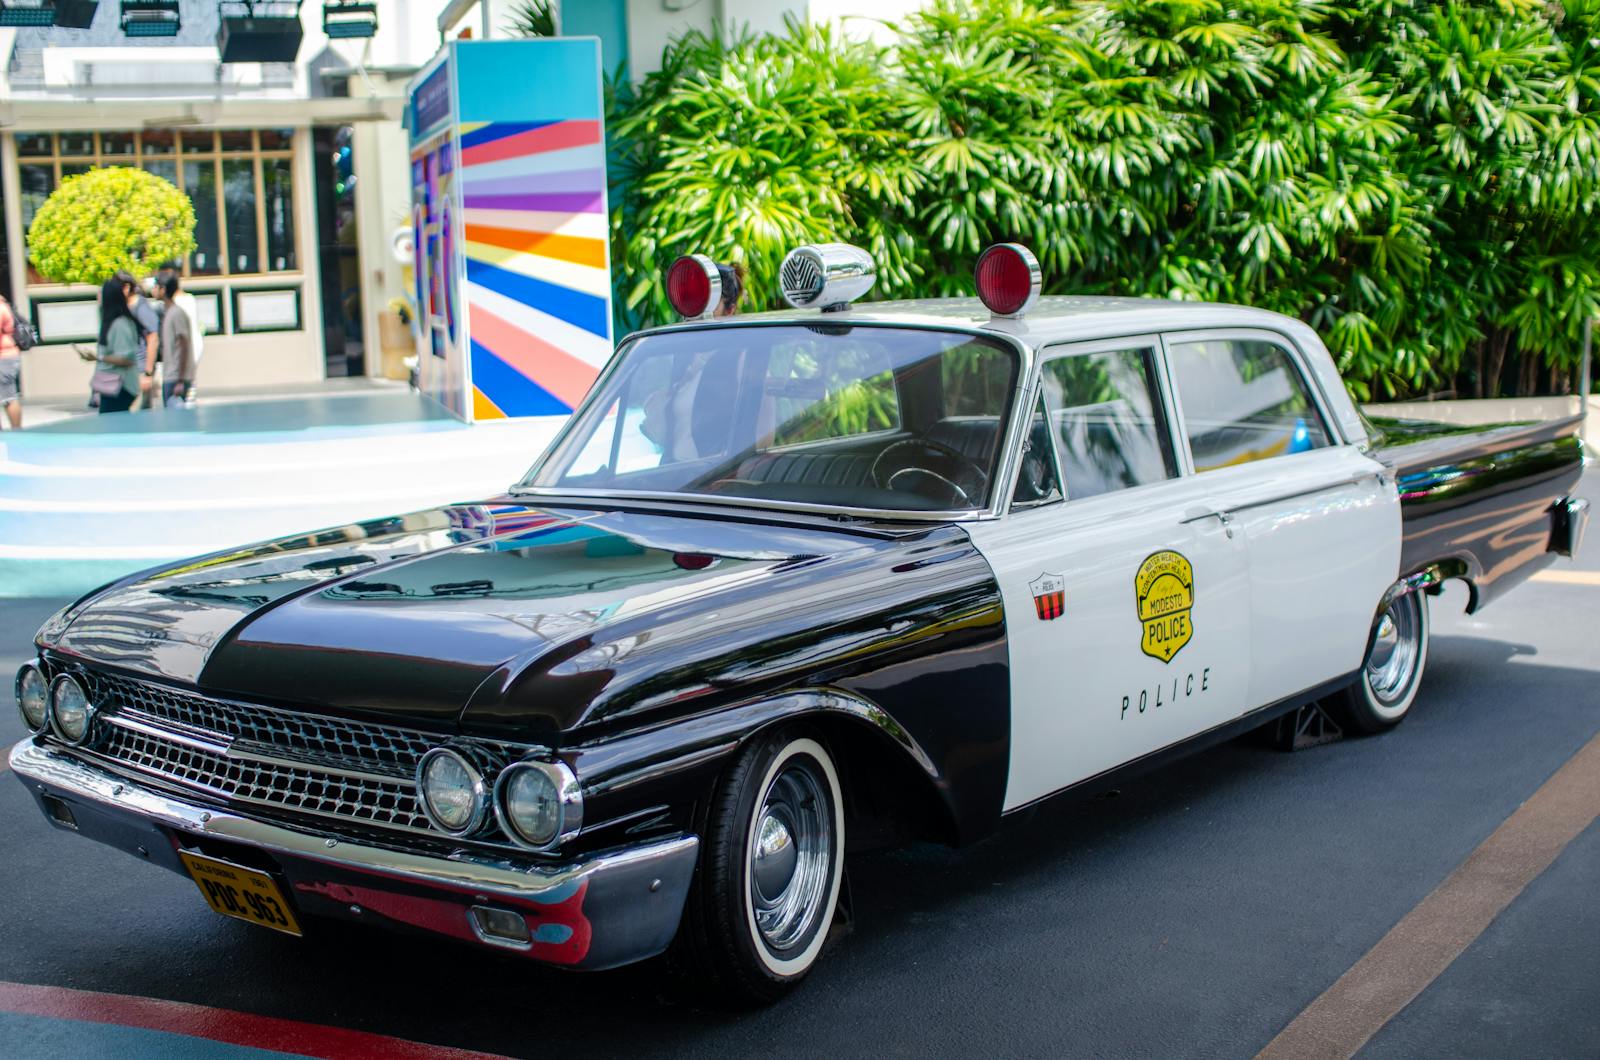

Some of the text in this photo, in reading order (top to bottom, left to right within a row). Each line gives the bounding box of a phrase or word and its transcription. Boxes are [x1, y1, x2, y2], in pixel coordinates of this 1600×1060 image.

[1145, 553, 1182, 573] WATER WEALTH
[1171, 563, 1188, 583] HEALTH
[1150, 593, 1183, 614] MODESTO
[1149, 615, 1186, 646] POLICE
[1121, 667, 1210, 720] POLICE
[191, 861, 238, 880] CALIFORNIA
[201, 878, 289, 926] PDC 963
